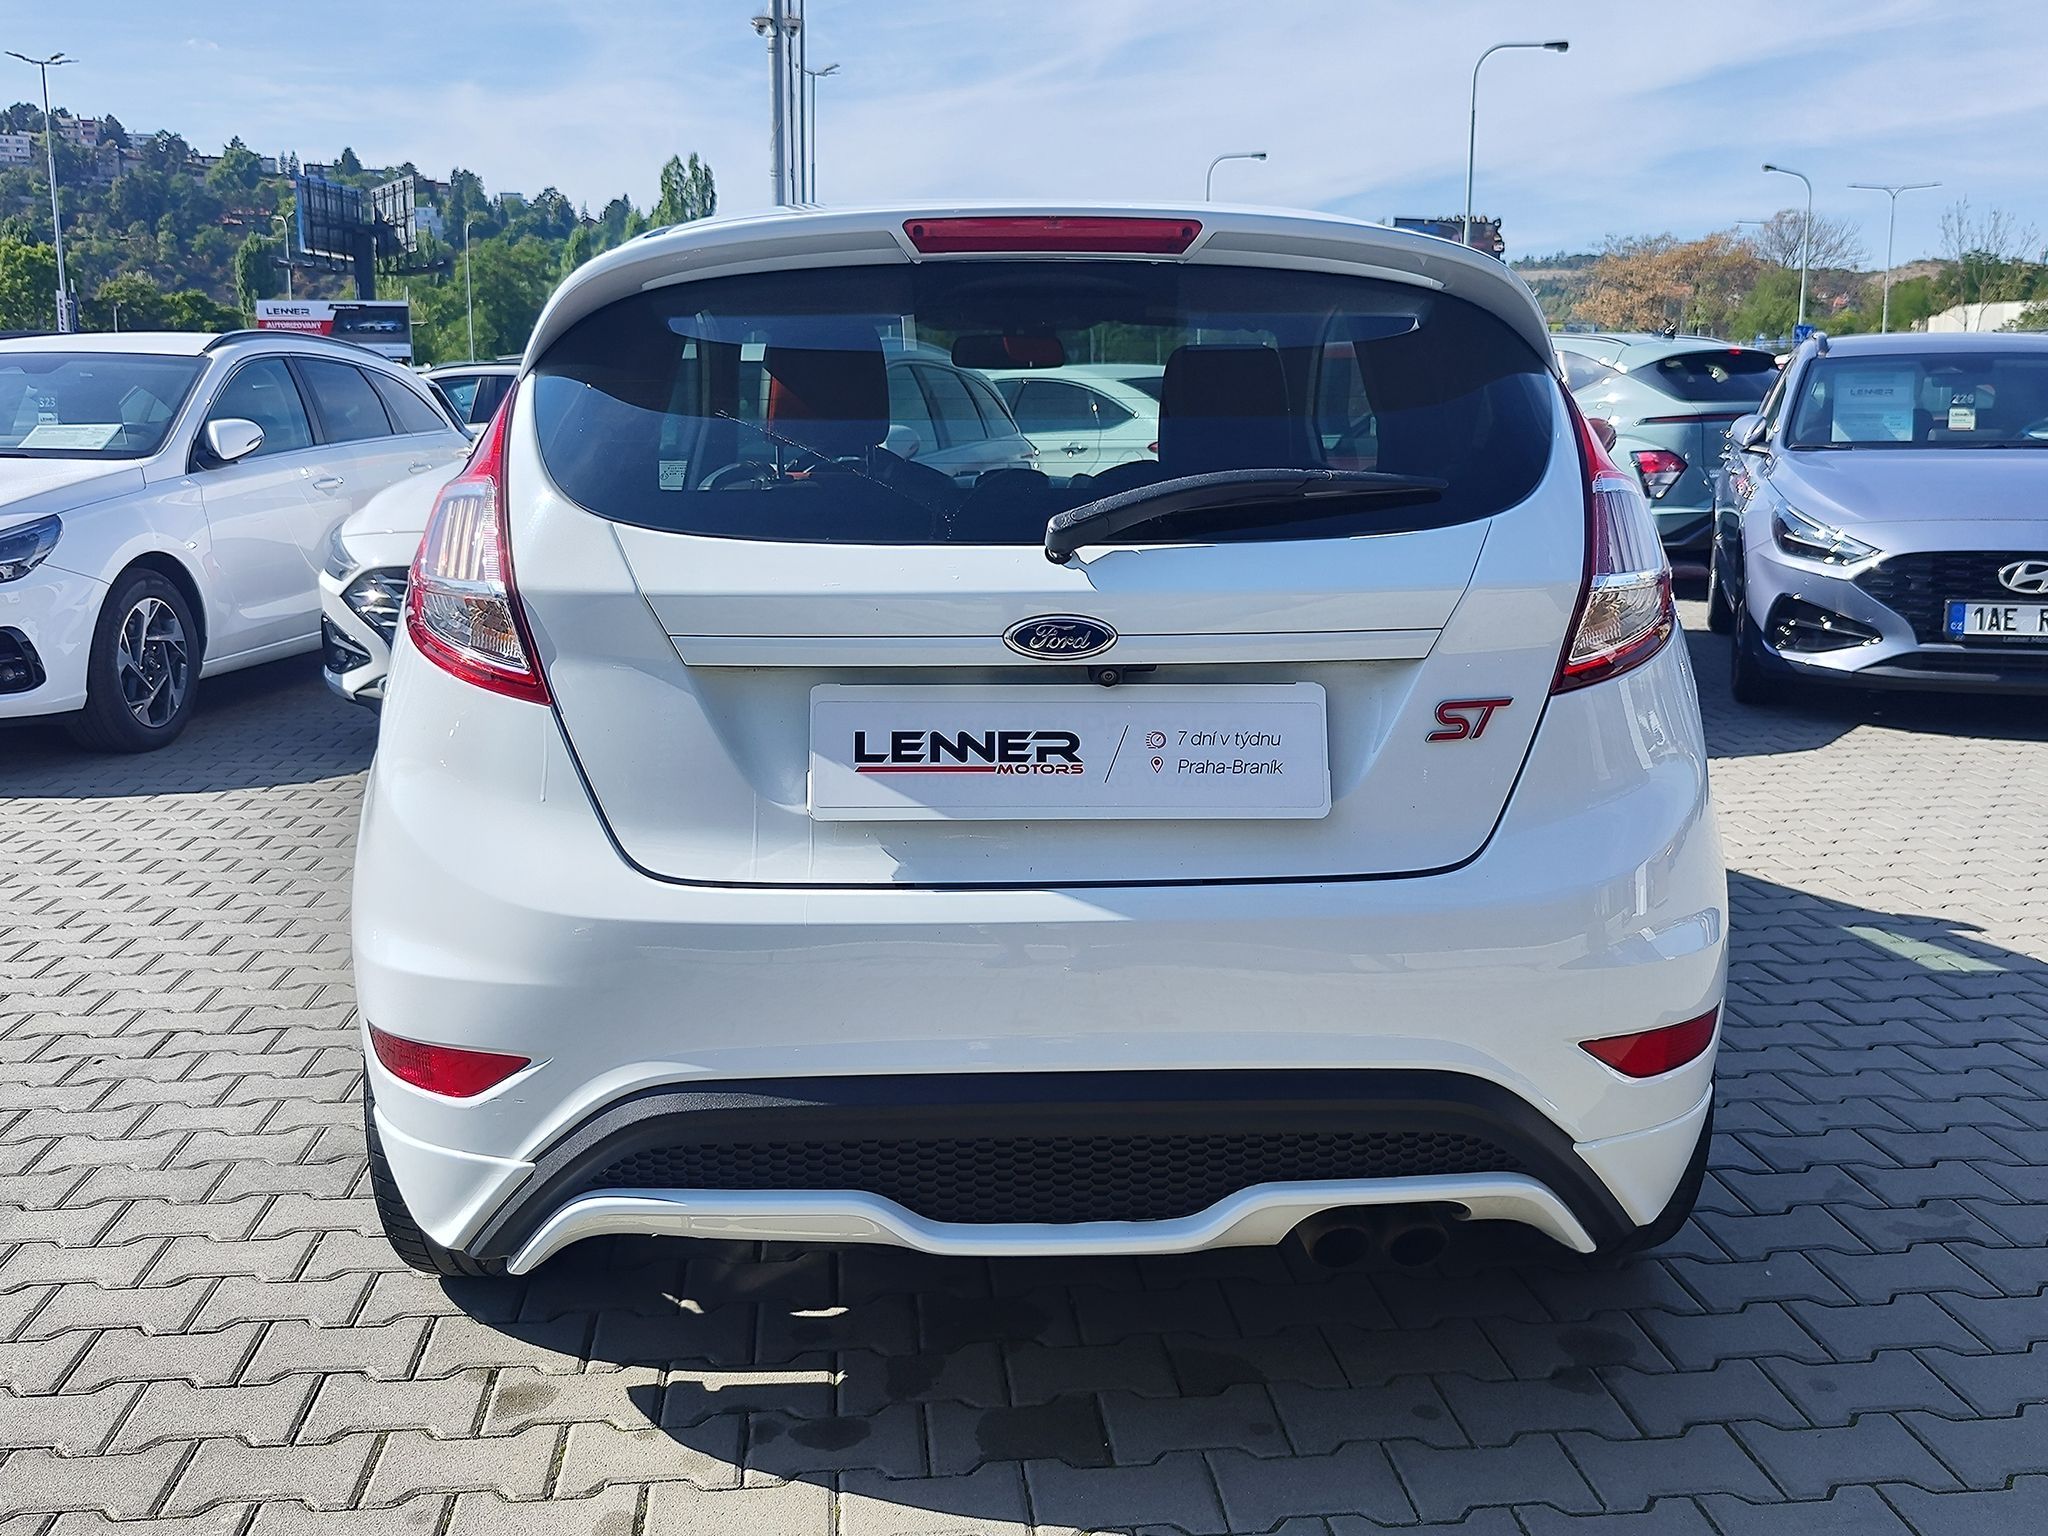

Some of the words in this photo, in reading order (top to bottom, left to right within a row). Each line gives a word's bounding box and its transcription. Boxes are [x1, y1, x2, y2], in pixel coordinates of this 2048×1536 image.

[266, 307, 311, 316] LENNER
[1973, 607, 2018, 631] 1AE
[1029, 624, 1091, 649] Ford
[1425, 696, 1514, 743] ST
[854, 731, 1084, 763] LENNER
[1178, 731, 1188, 746] 7
[1190, 730, 1218, 746] dní
[1220, 734, 1231, 746] v
[1234, 730, 1282, 749] týdnu
[996, 763, 1084, 774] MOTORS
[1177, 758, 1284, 775] Praha-Braník
